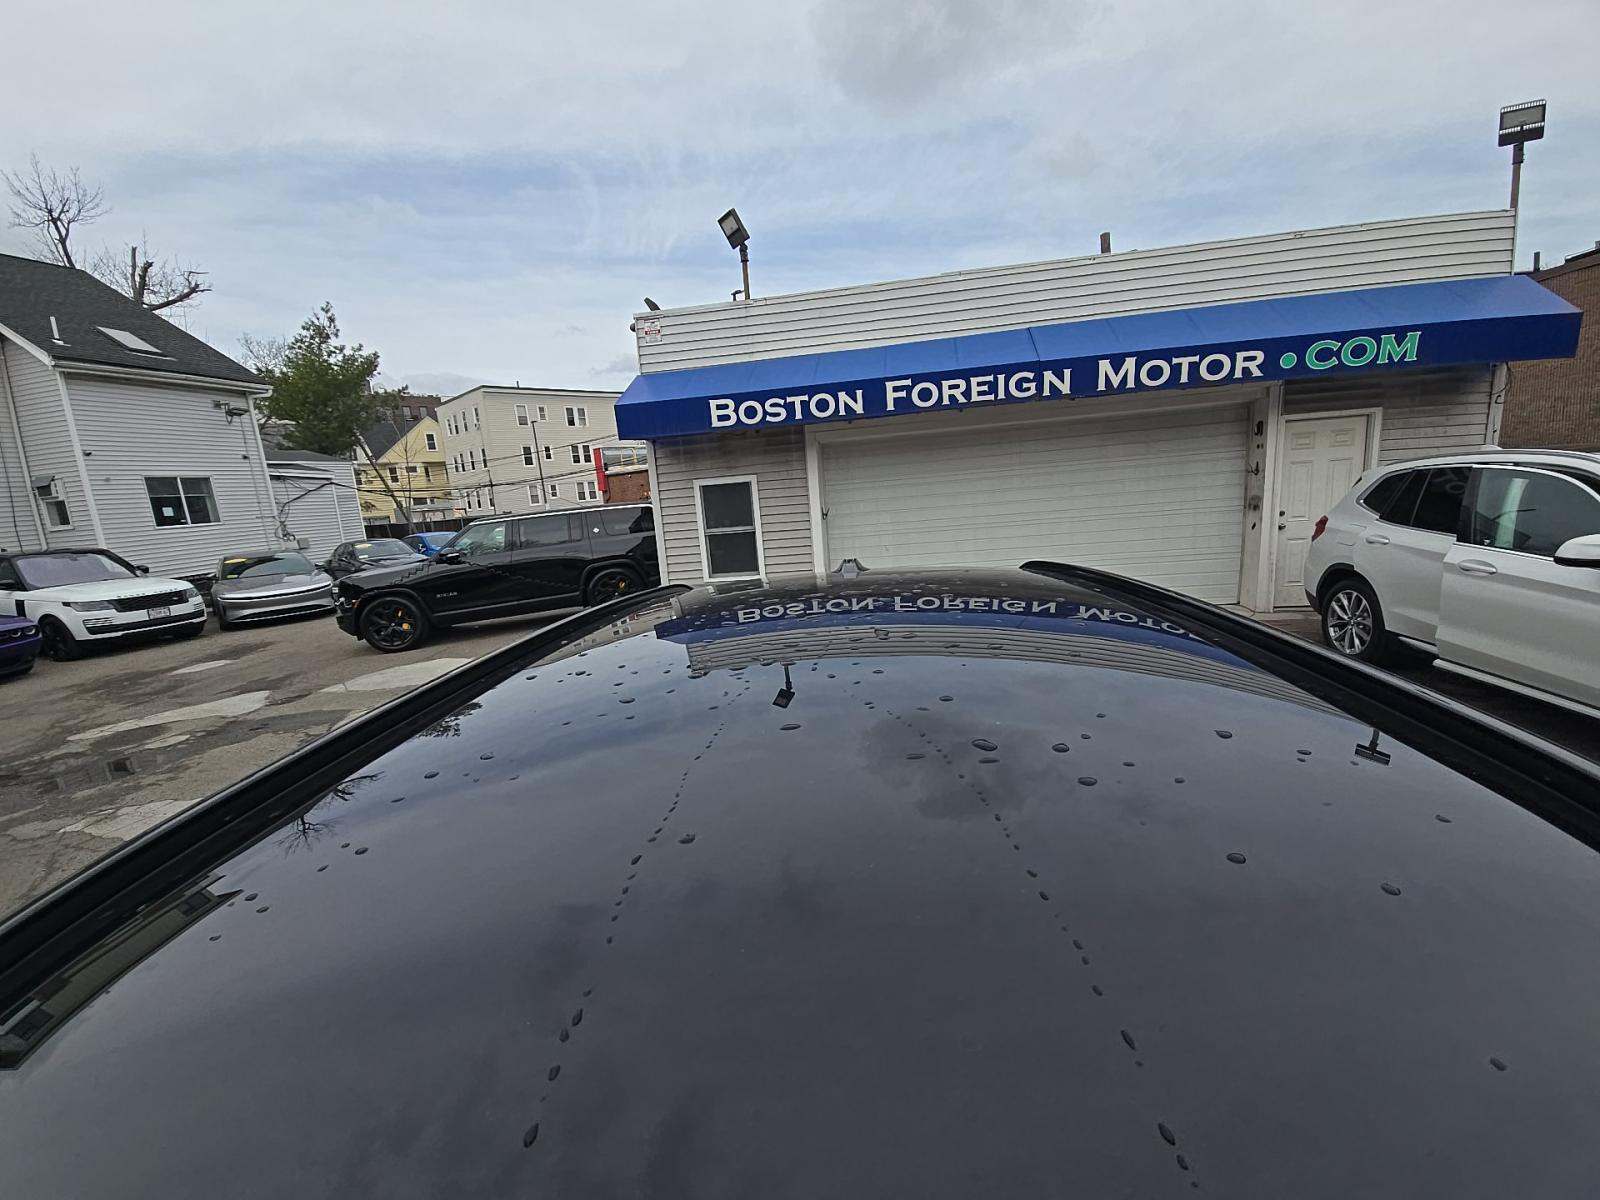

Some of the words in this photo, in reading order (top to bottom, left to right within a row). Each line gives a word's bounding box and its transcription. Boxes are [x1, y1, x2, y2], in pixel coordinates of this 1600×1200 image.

[708, 389, 864, 428] BOSTON
[884, 368, 1072, 411] FOREIGN
[1096, 350, 1266, 392] MOTOR
